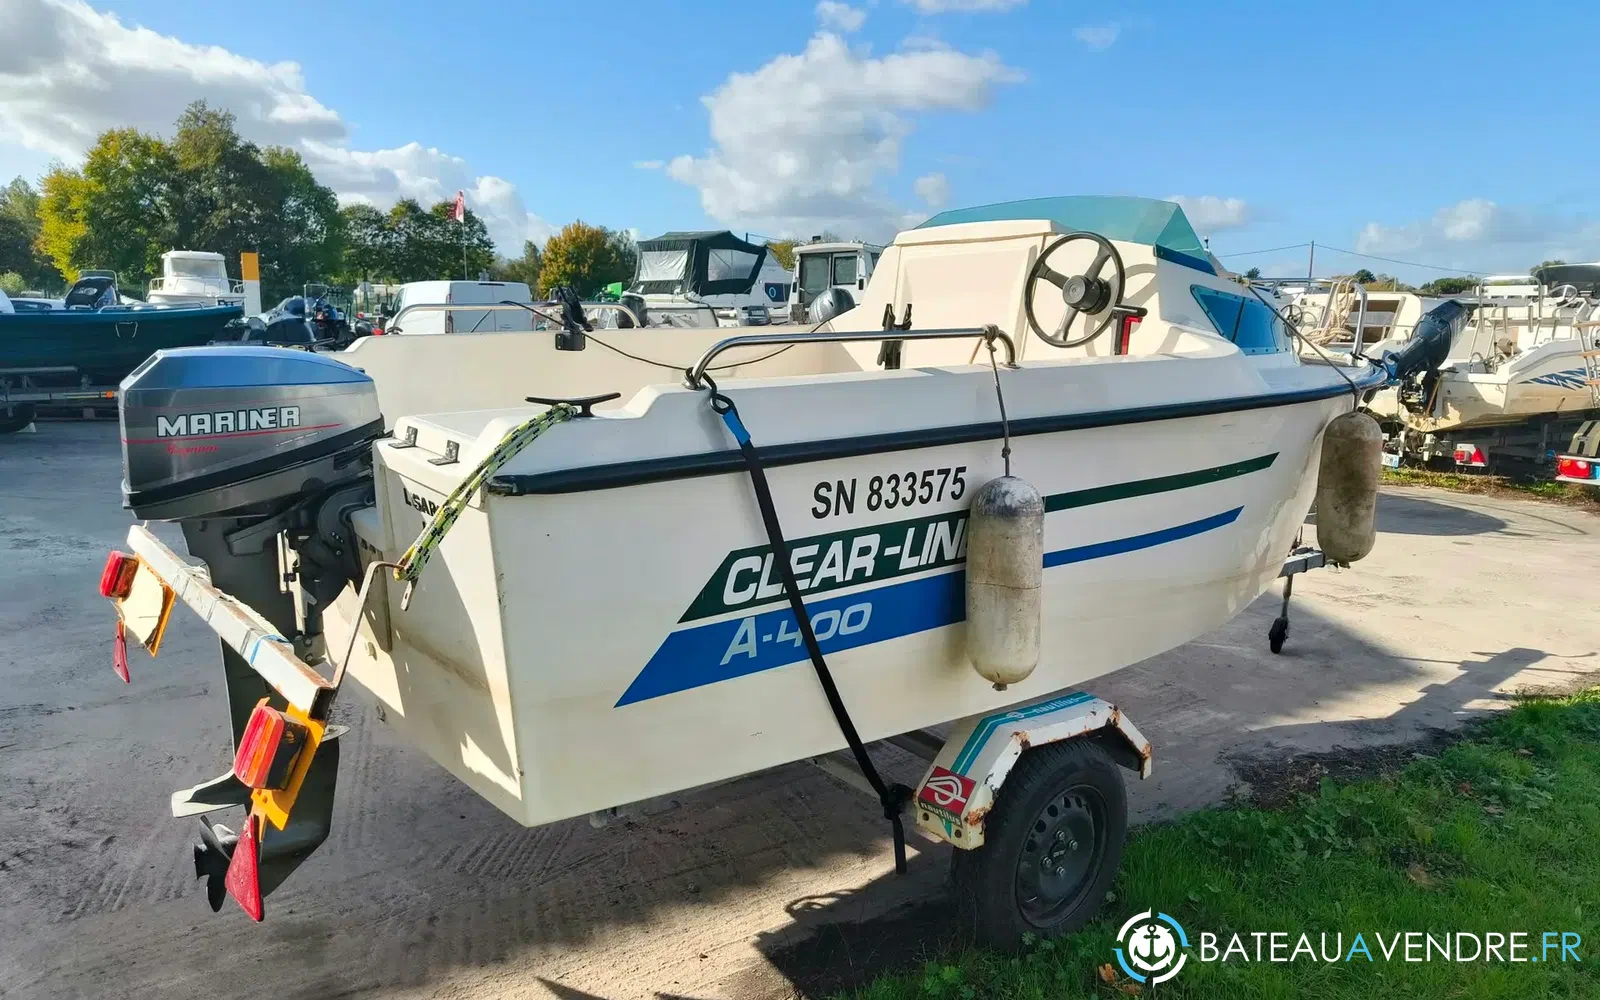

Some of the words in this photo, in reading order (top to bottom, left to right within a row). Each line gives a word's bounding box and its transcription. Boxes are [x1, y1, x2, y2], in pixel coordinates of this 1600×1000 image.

[156, 405, 300, 438] MARINER
[811, 478, 857, 519] SN
[866, 466, 967, 511] 833575
[719, 602, 873, 666] A-400
